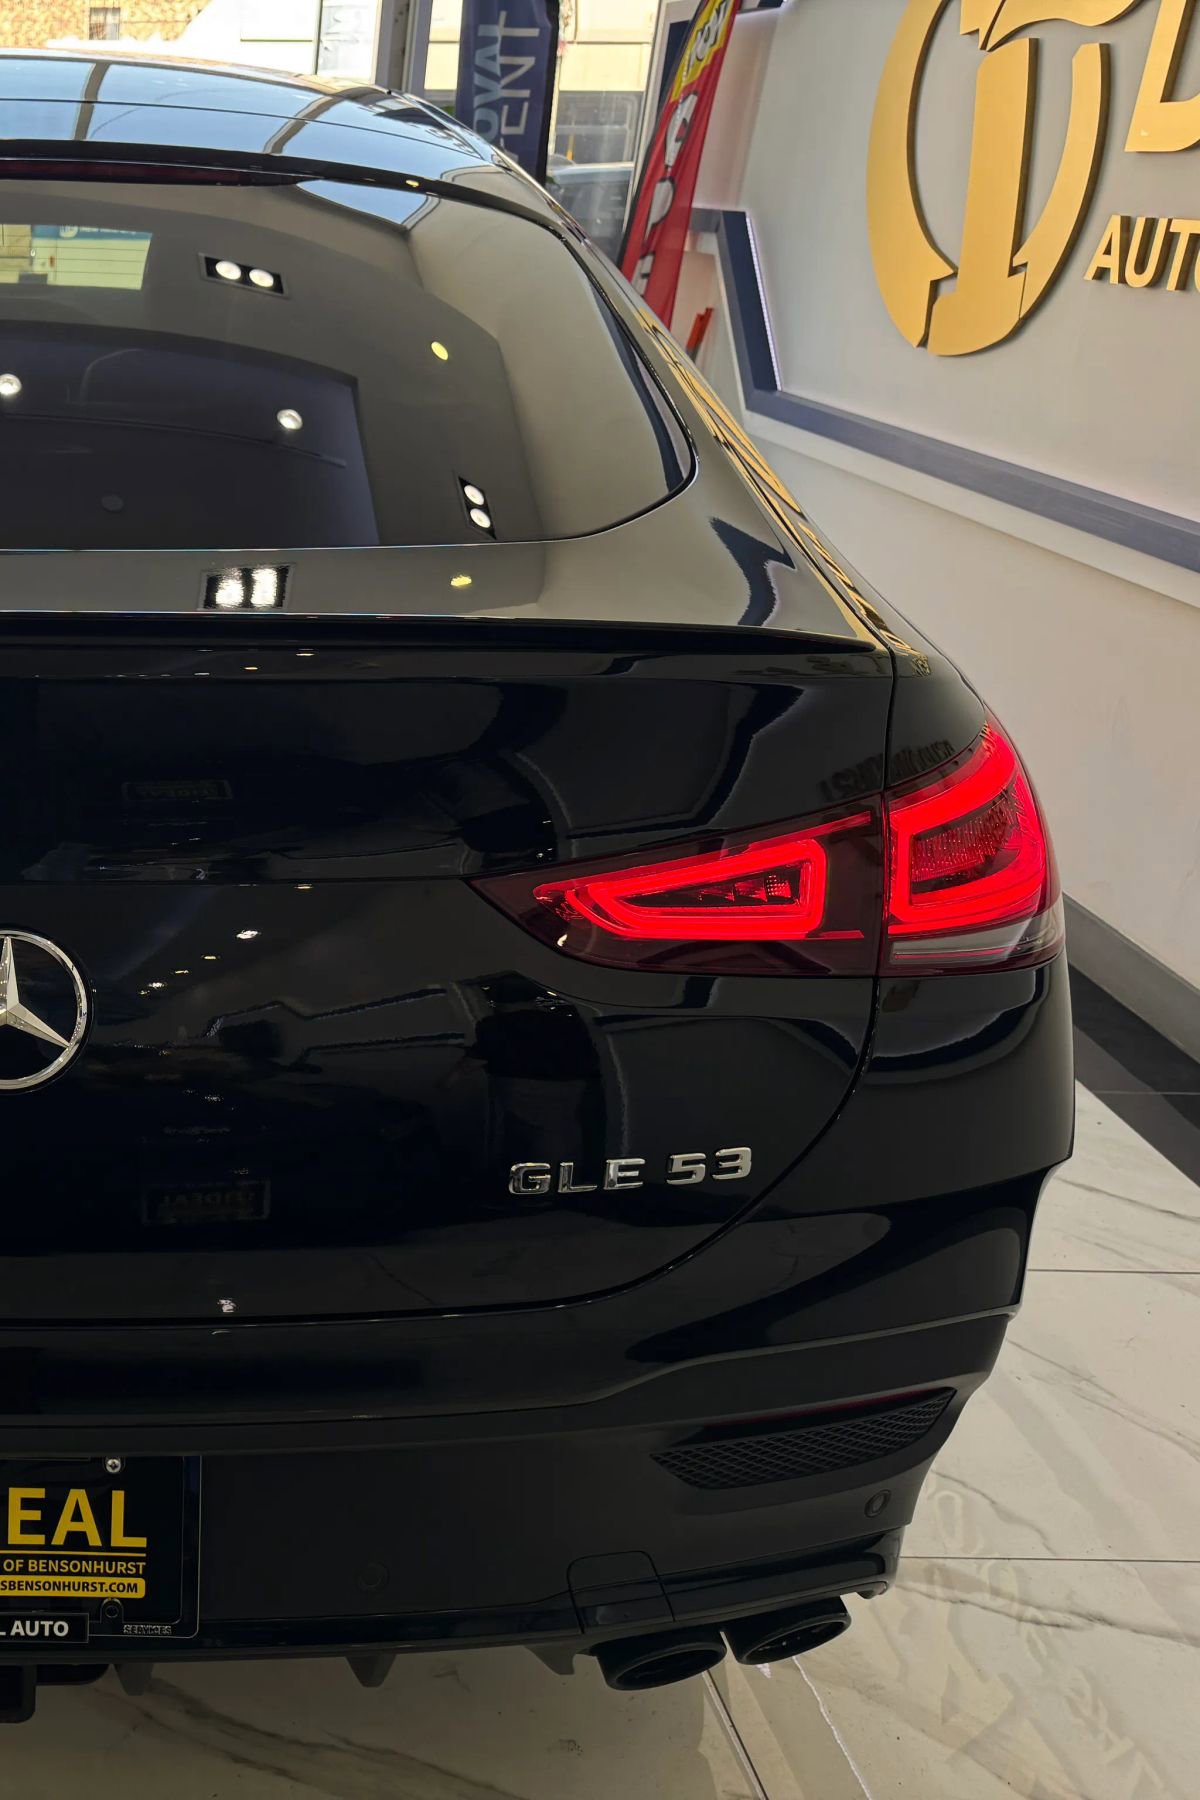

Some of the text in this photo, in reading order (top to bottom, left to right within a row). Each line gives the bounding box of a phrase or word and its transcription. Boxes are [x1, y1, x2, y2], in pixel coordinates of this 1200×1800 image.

[1084, 214, 1200, 294] AUT
[508, 1146, 753, 1195] GLE 53
[3, 1558, 25, 1573] OF
[28, 1559, 147, 1576] BENSONHURST
[9, 1619, 70, 1638] AUTO
